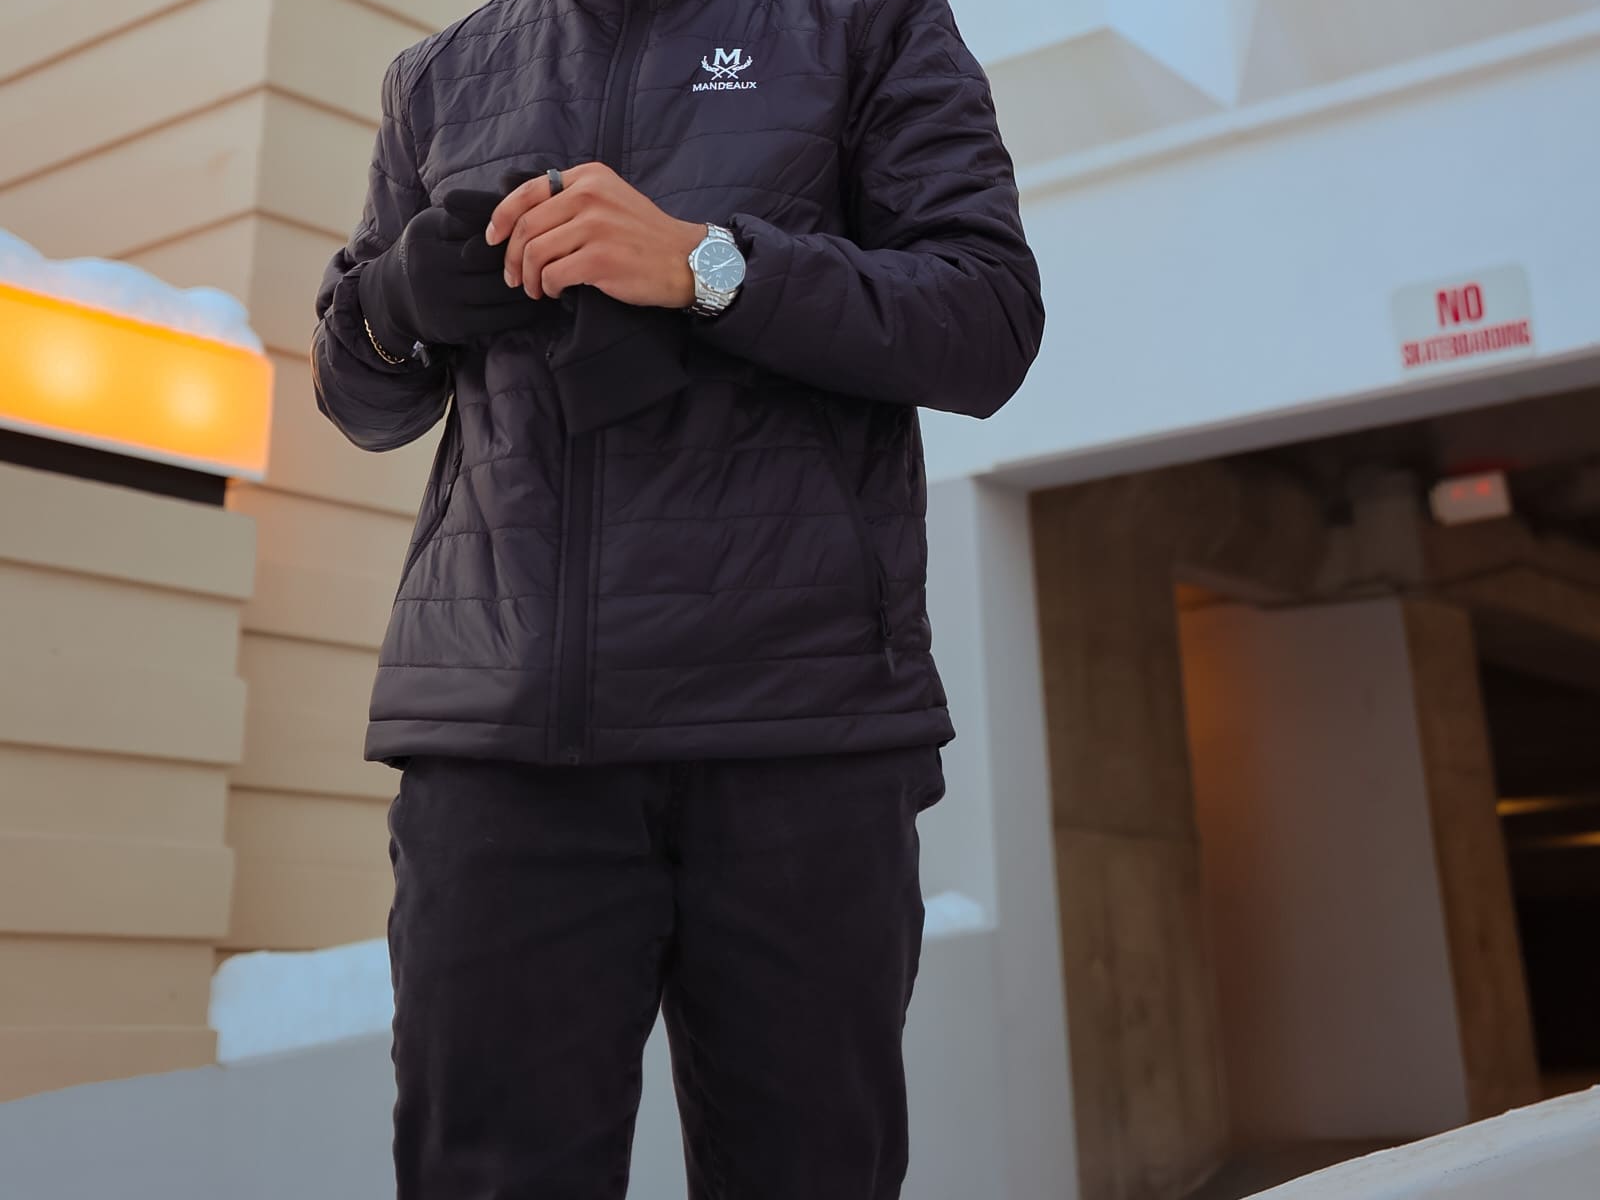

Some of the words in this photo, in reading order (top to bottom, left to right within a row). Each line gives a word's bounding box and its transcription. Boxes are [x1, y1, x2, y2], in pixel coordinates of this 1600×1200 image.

[713, 47, 742, 66] M
[692, 81, 757, 92] MANDEAUX
[1436, 283, 1484, 327] NO
[1402, 320, 1531, 368] SKATEBOARDING
